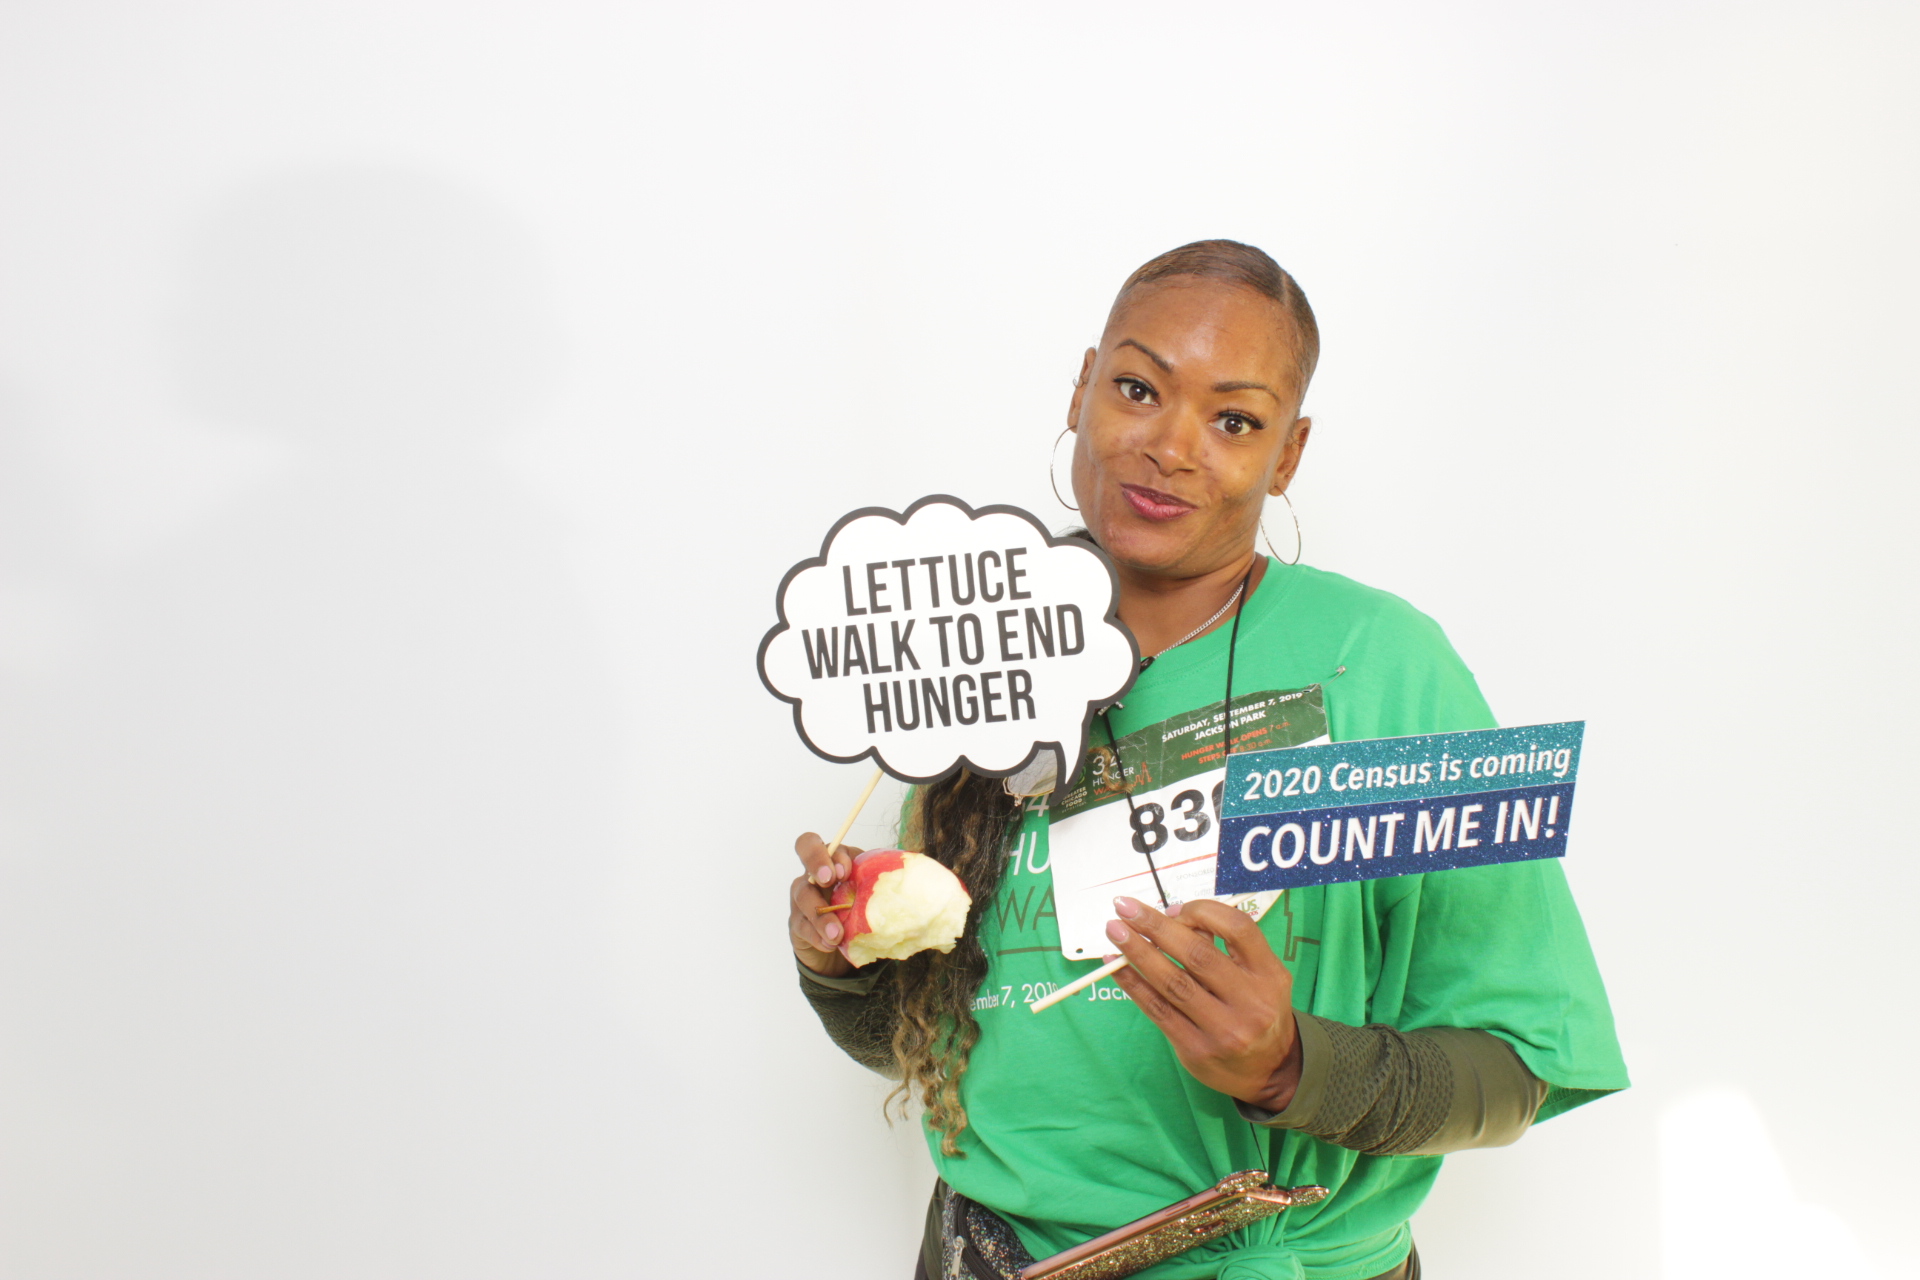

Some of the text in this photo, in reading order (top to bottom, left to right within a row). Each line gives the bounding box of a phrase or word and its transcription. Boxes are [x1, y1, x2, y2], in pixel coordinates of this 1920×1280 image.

[842, 547, 1031, 616] LETTUCE
[802, 603, 1085, 679] WALK TO END
[863, 669, 1036, 733] HUNGER
[1161, 718, 1210, 743] SATURDAY,
[1268, 698, 1276, 706] 7,
[1279, 692, 1303, 703] 2019
[1240, 710, 1267, 725] PARK
[1181, 744, 1215, 760] HUNGER
[1215, 737, 1240, 749] WLK
[1240, 727, 1268, 741] OPENS
[1198, 752, 1221, 764] STEPS
[1244, 744, 1571, 800] 2020 Census is coming
[1241, 796, 1559, 872] COUNT ME IN!
[1001, 986, 1016, 1009] 7,
